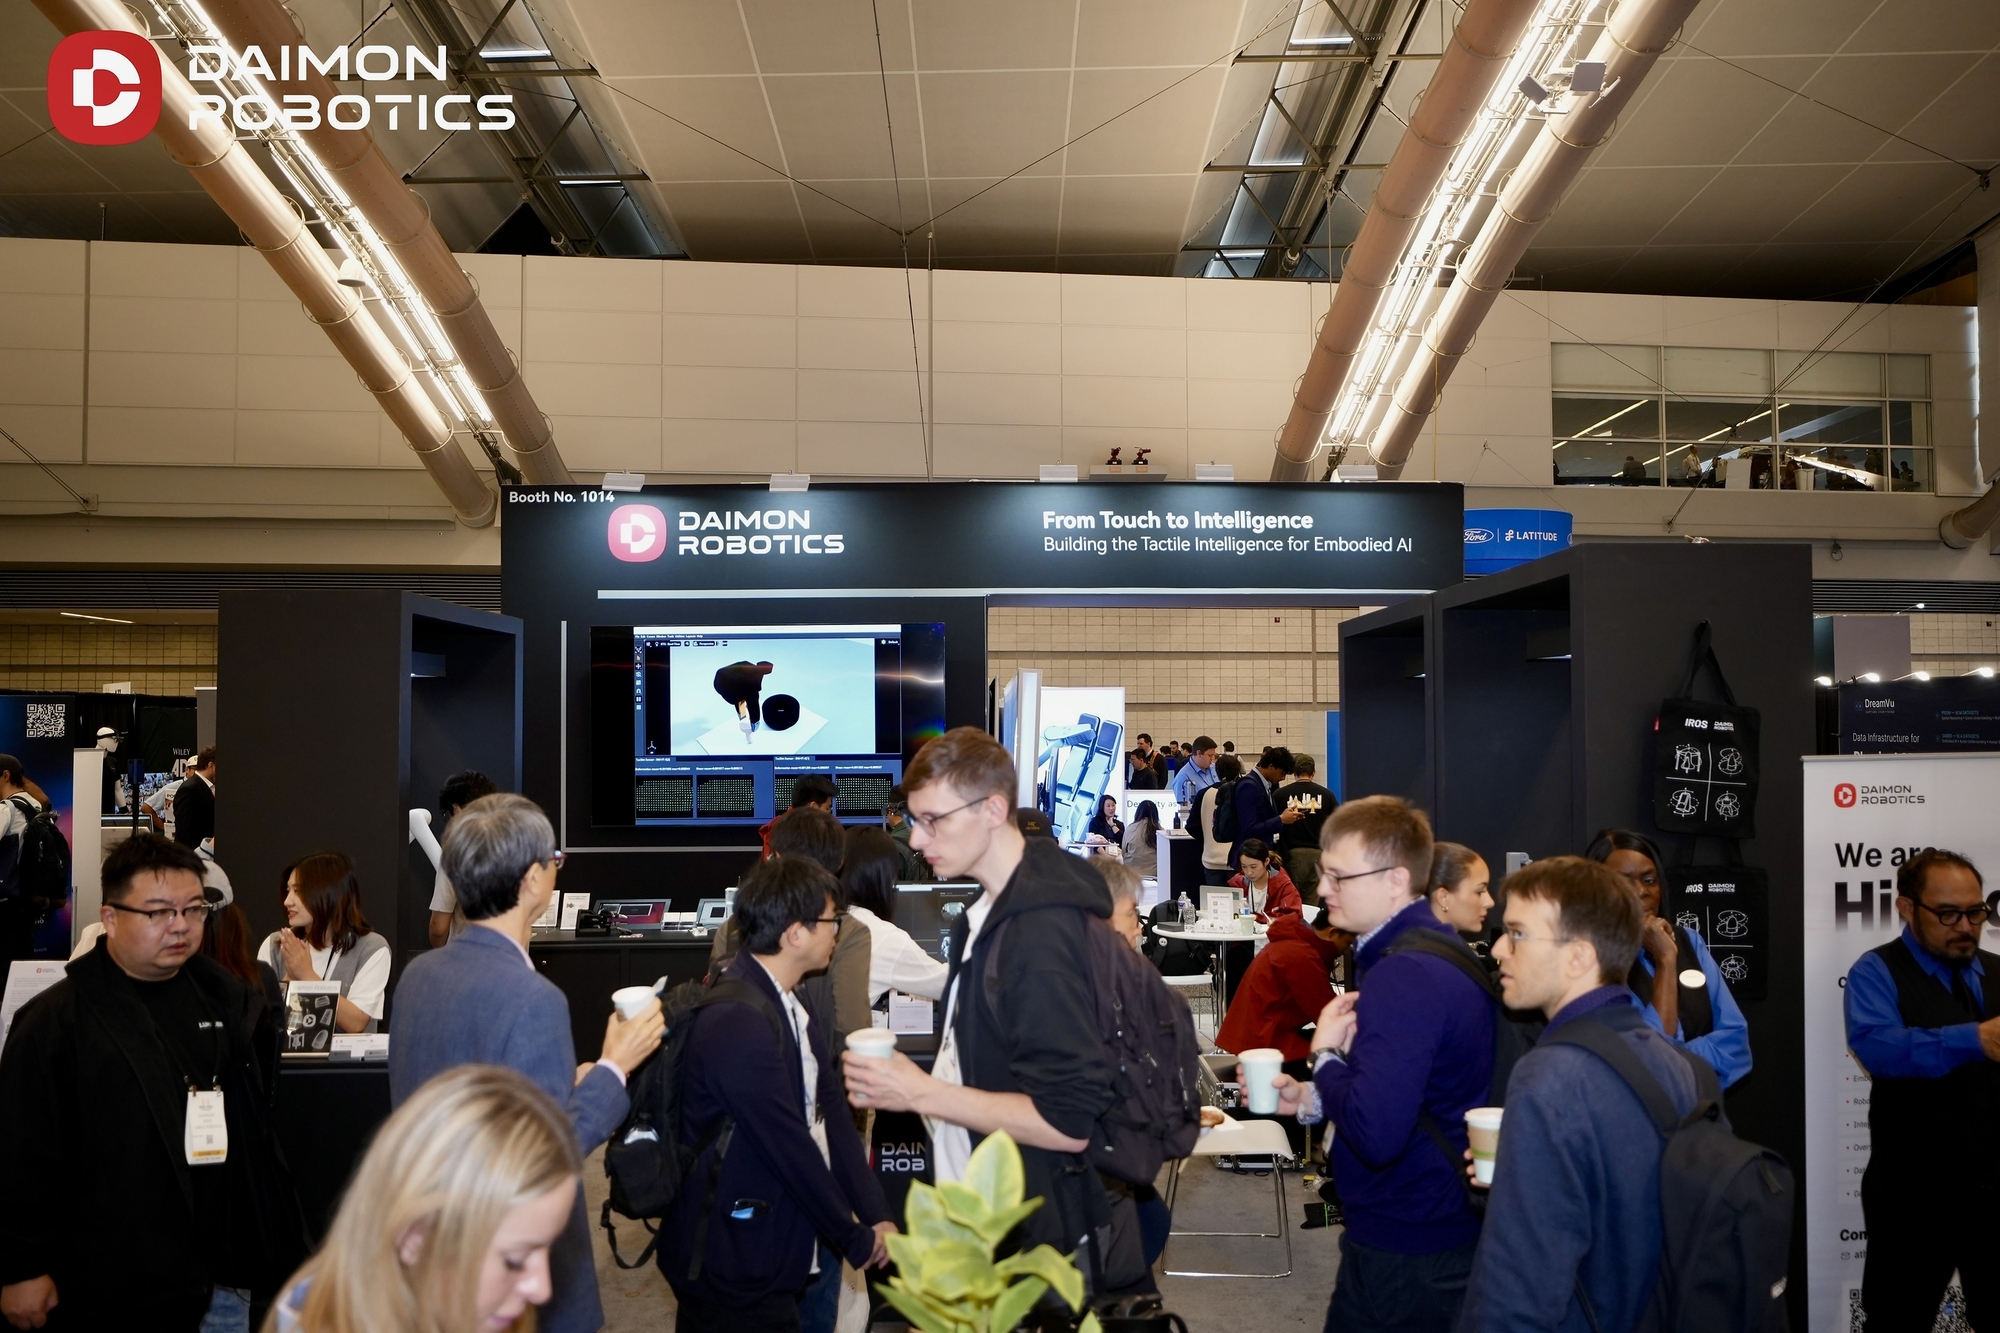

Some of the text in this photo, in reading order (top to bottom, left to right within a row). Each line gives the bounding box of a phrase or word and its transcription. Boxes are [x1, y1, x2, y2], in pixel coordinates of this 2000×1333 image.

[509, 491, 615, 503] Booth No. 1014
[679, 510, 811, 530] DAIMON
[1043, 510, 1313, 532] From Touch to Intelligence
[1464, 530, 1487, 541] Ford
[1516, 532, 1558, 541] LATITUDE
[679, 535, 845, 555] ROBOTICS
[1044, 535, 1412, 556] Building the Tactile Intelligence for Embodied AI
[1865, 698, 1895, 708] DreamVu
[1684, 718, 1708, 729] IROS
[1853, 732, 1920, 743] Data Infrastructure for
[1861, 785, 1912, 794] DAIMON
[1861, 796, 1925, 804] ROBOTICS
[1834, 842, 1938, 867] We ar
[1685, 884, 1703, 893] IROS
